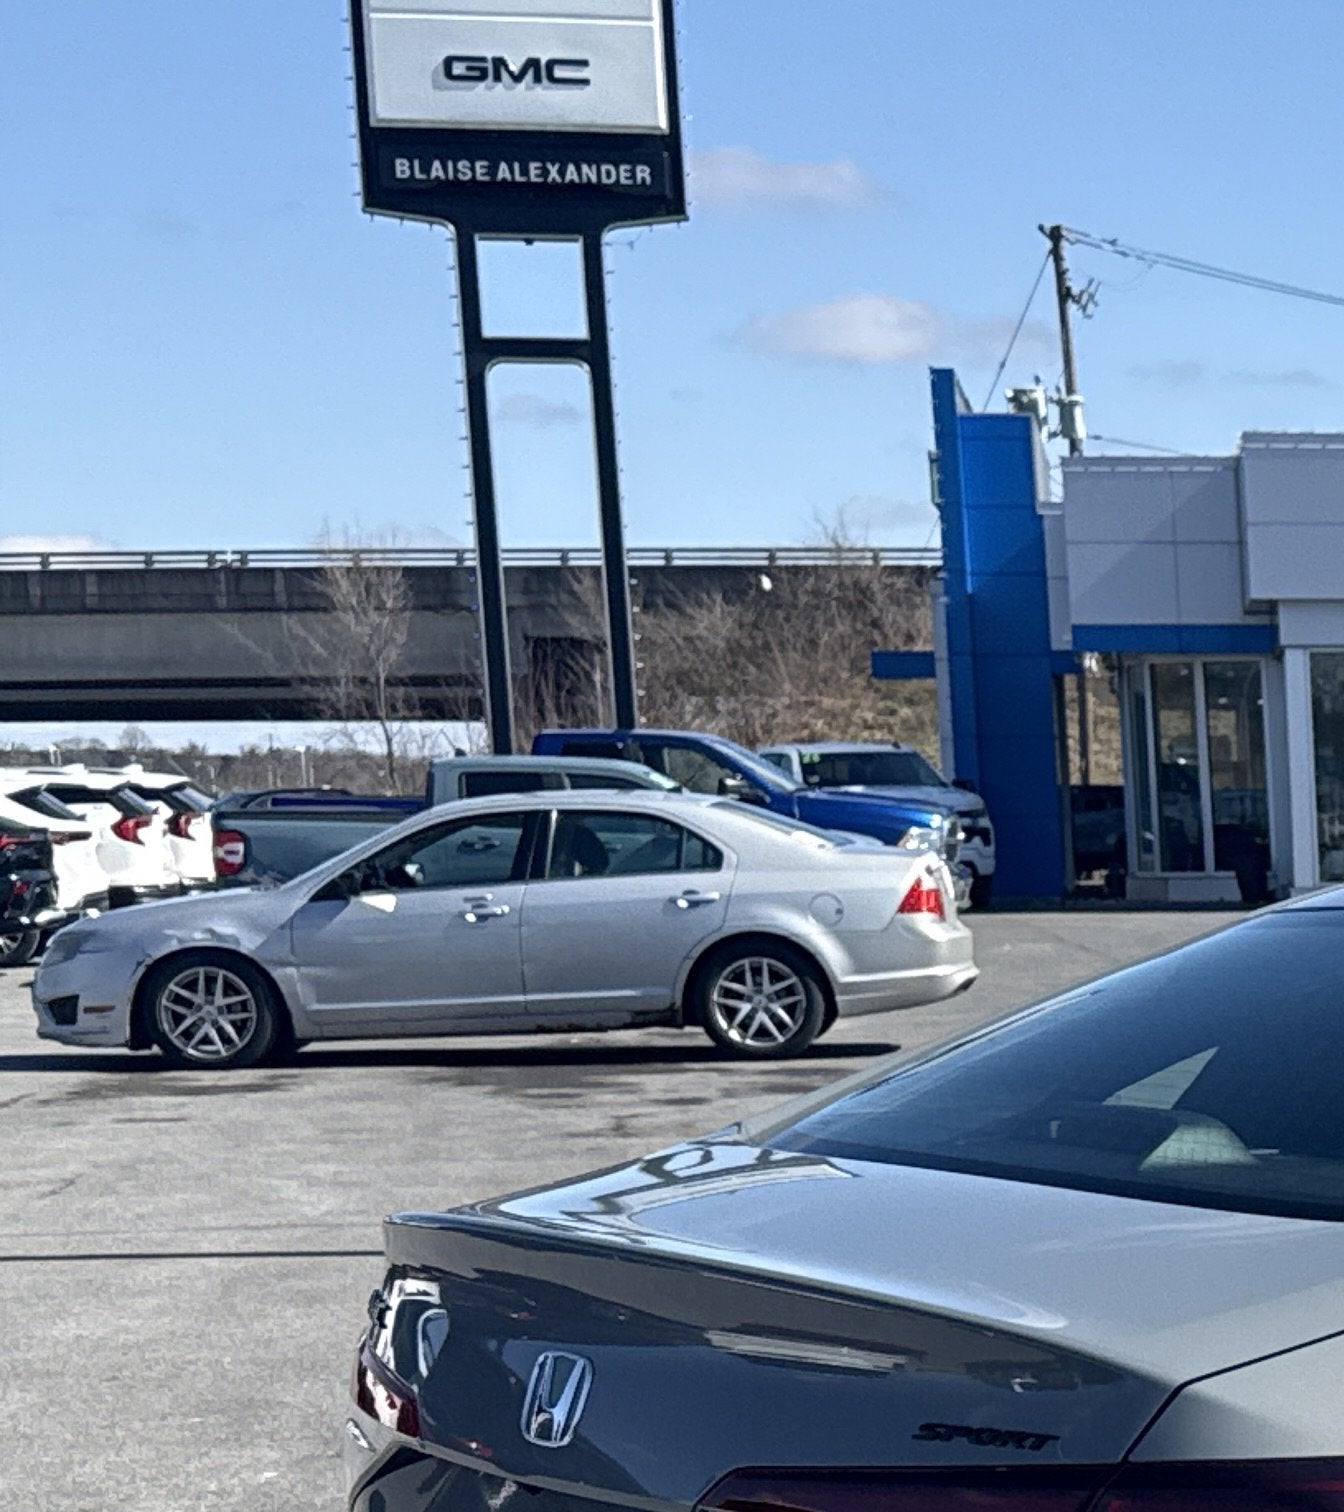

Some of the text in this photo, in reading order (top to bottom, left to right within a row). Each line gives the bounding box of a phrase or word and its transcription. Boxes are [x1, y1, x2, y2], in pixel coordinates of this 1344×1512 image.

[443, 55, 591, 86] GMC
[395, 157, 652, 187] BLAISE ALEXANDER
[911, 1422, 1062, 1451] SPORT
